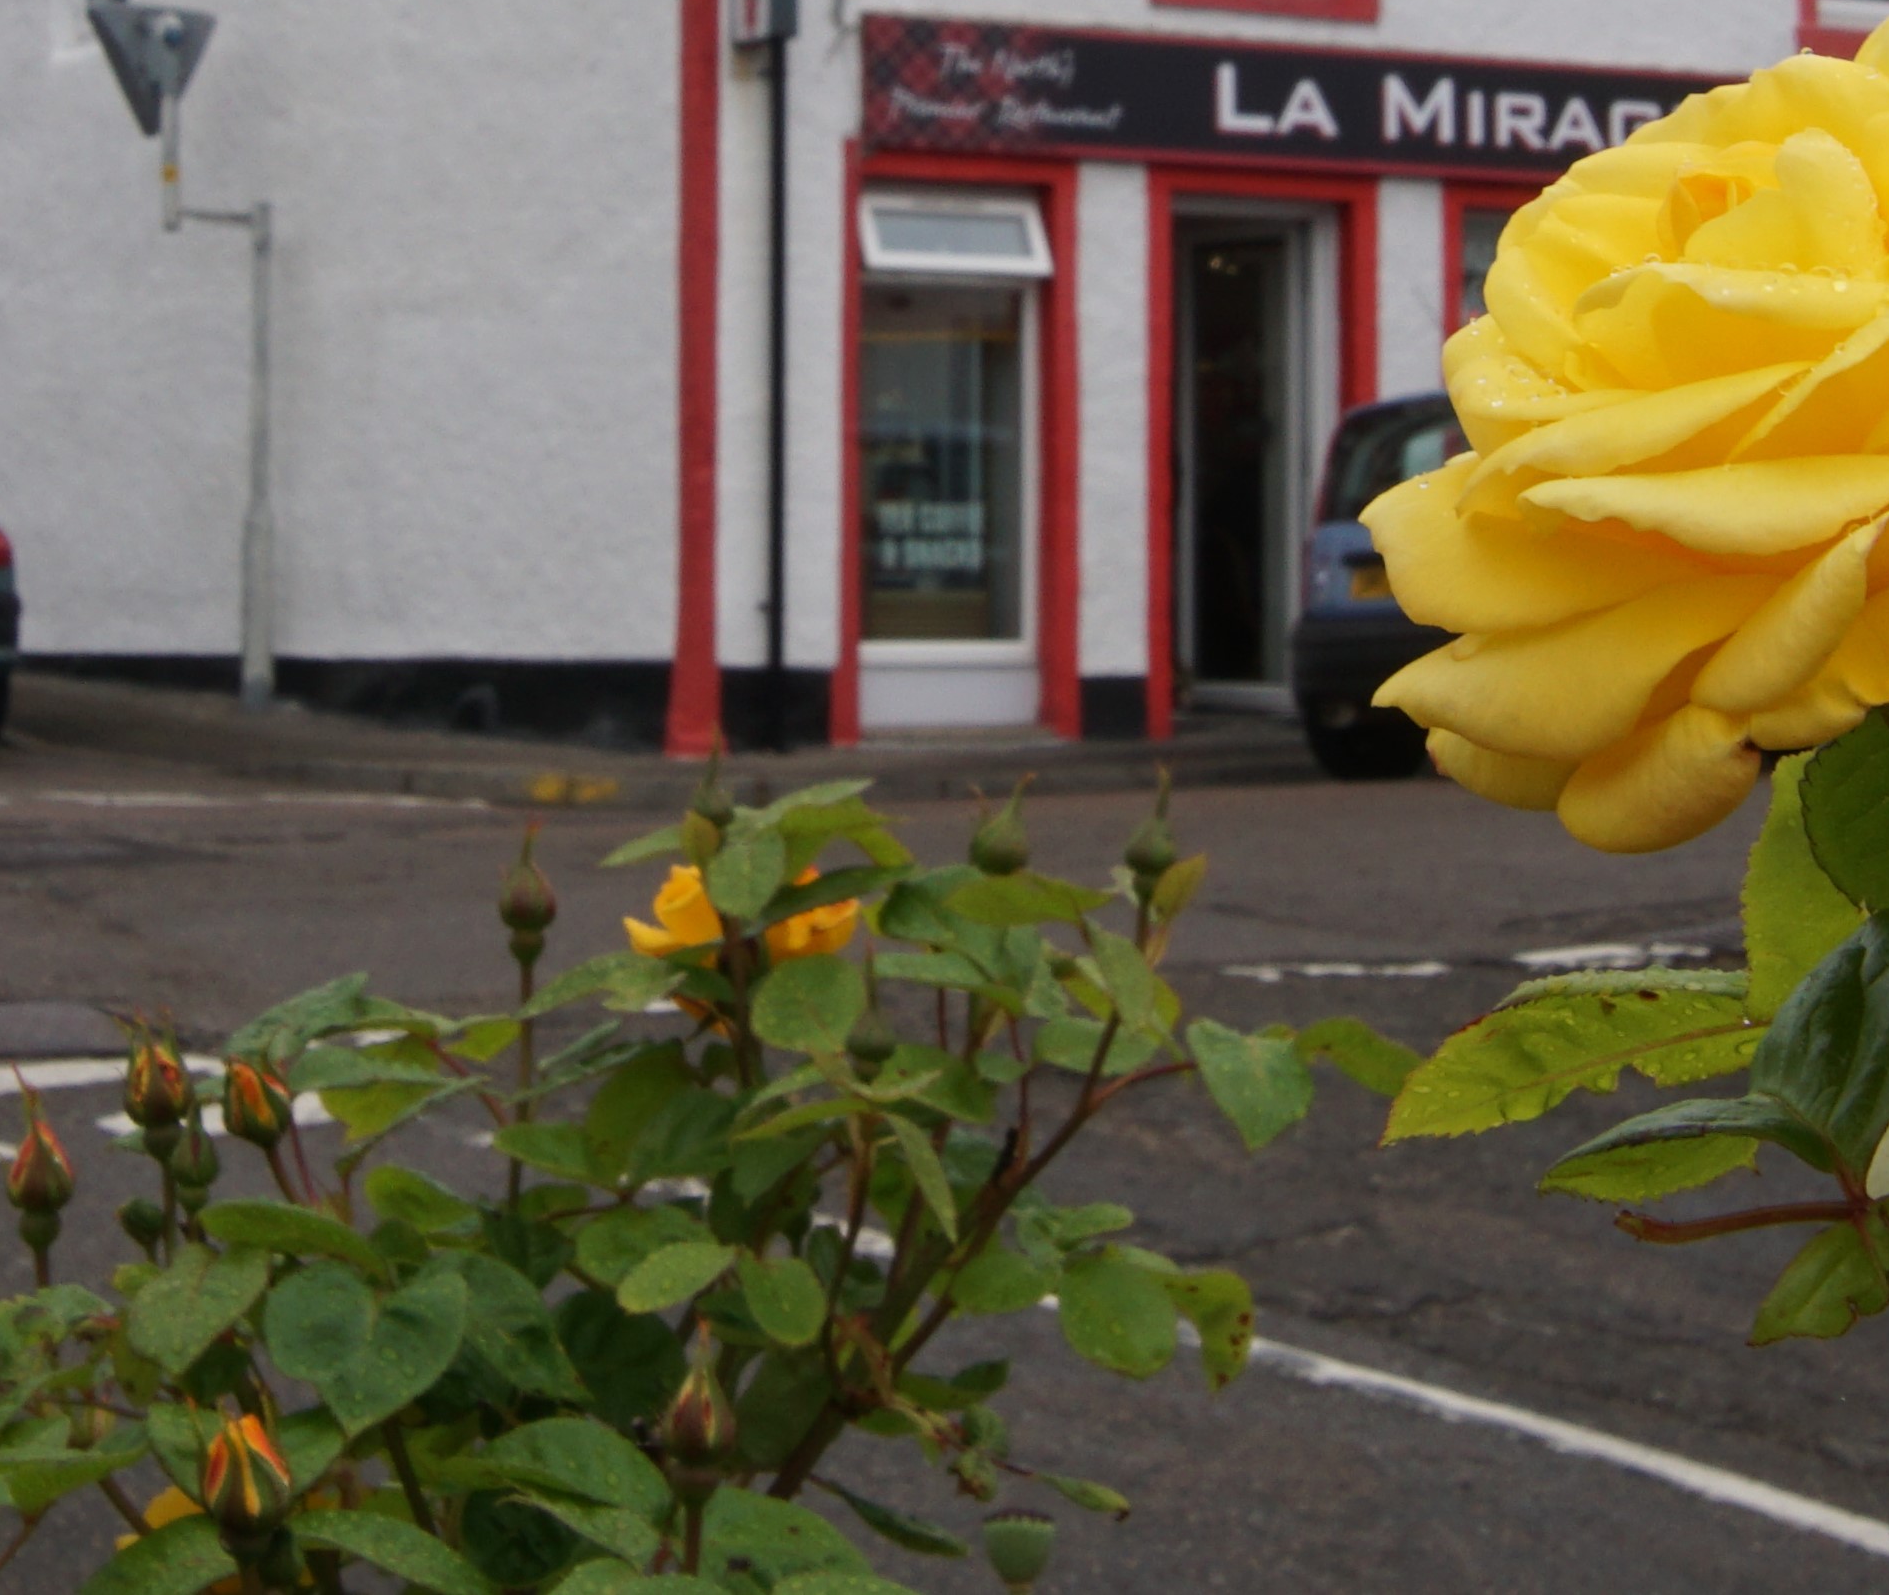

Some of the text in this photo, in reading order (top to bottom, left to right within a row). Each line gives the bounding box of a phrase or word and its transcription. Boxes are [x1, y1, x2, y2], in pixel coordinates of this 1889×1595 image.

[939, 41, 983, 78] The
[1215, 61, 1666, 153] LA MIRAG
